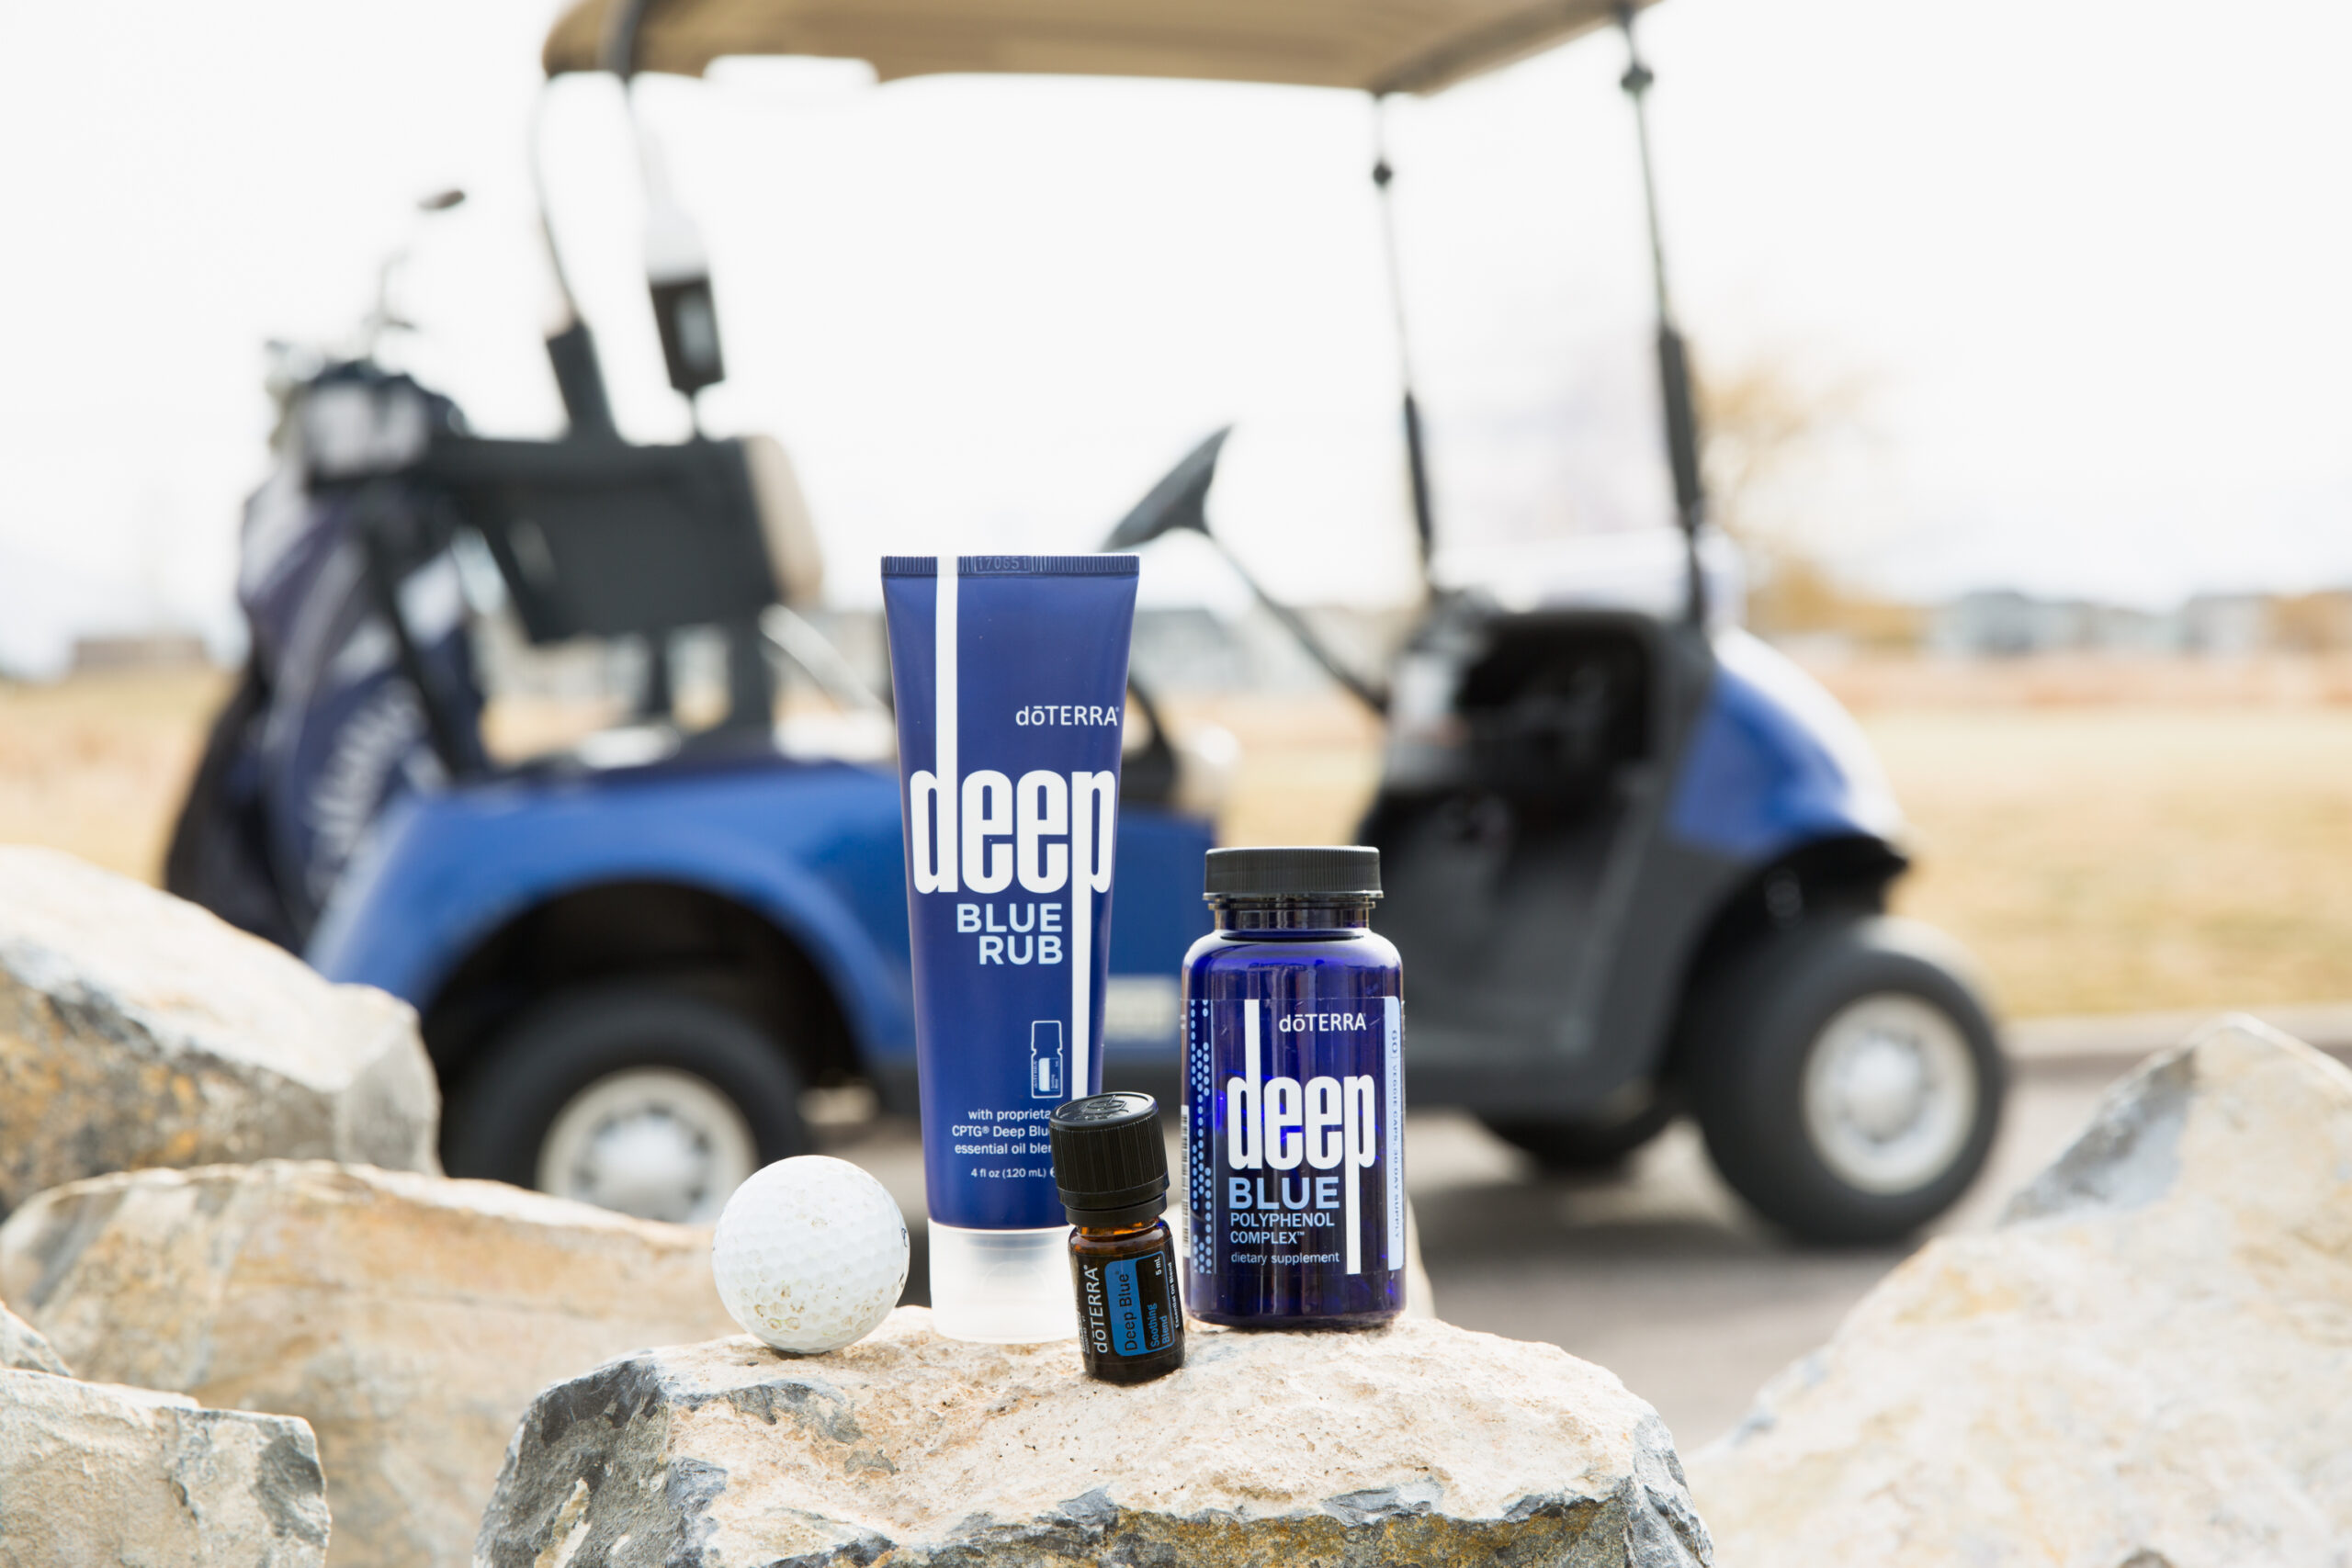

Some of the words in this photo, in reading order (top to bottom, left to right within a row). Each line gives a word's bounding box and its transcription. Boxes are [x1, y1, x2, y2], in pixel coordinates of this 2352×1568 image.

[957, 903, 1063, 933] BLUE
[979, 935, 1063, 965] RUB
[968, 1109, 993, 1121] with
[997, 1109, 1050, 1122] proprieta
[993, 1125, 1026, 1139] Deep
[1029, 1125, 1050, 1137] Blu
[955, 1143, 1009, 1155] essential
[1012, 1143, 1026, 1155] oil
[1030, 1143, 1052, 1155] ble
[971, 1168, 978, 1178] 4
[979, 1168, 987, 1178] fl
[989, 1170, 1001, 1179] oz
[1002, 1168, 1026, 1179] (120
[1028, 1168, 1047, 1179] mL)
[1228, 1177, 1340, 1211] BLUE
[1230, 1213, 1335, 1227] POLYPHENOL
[1154, 1257, 1160, 1269] mL
[1231, 1252, 1268, 1266] dietary
[1272, 1251, 1340, 1265] supplement
[1118, 1273, 1132, 1308] Blue
[1124, 1312, 1137, 1351] Deep
[1148, 1303, 1159, 1348] Soothing
[1159, 1315, 1170, 1344] Blend
